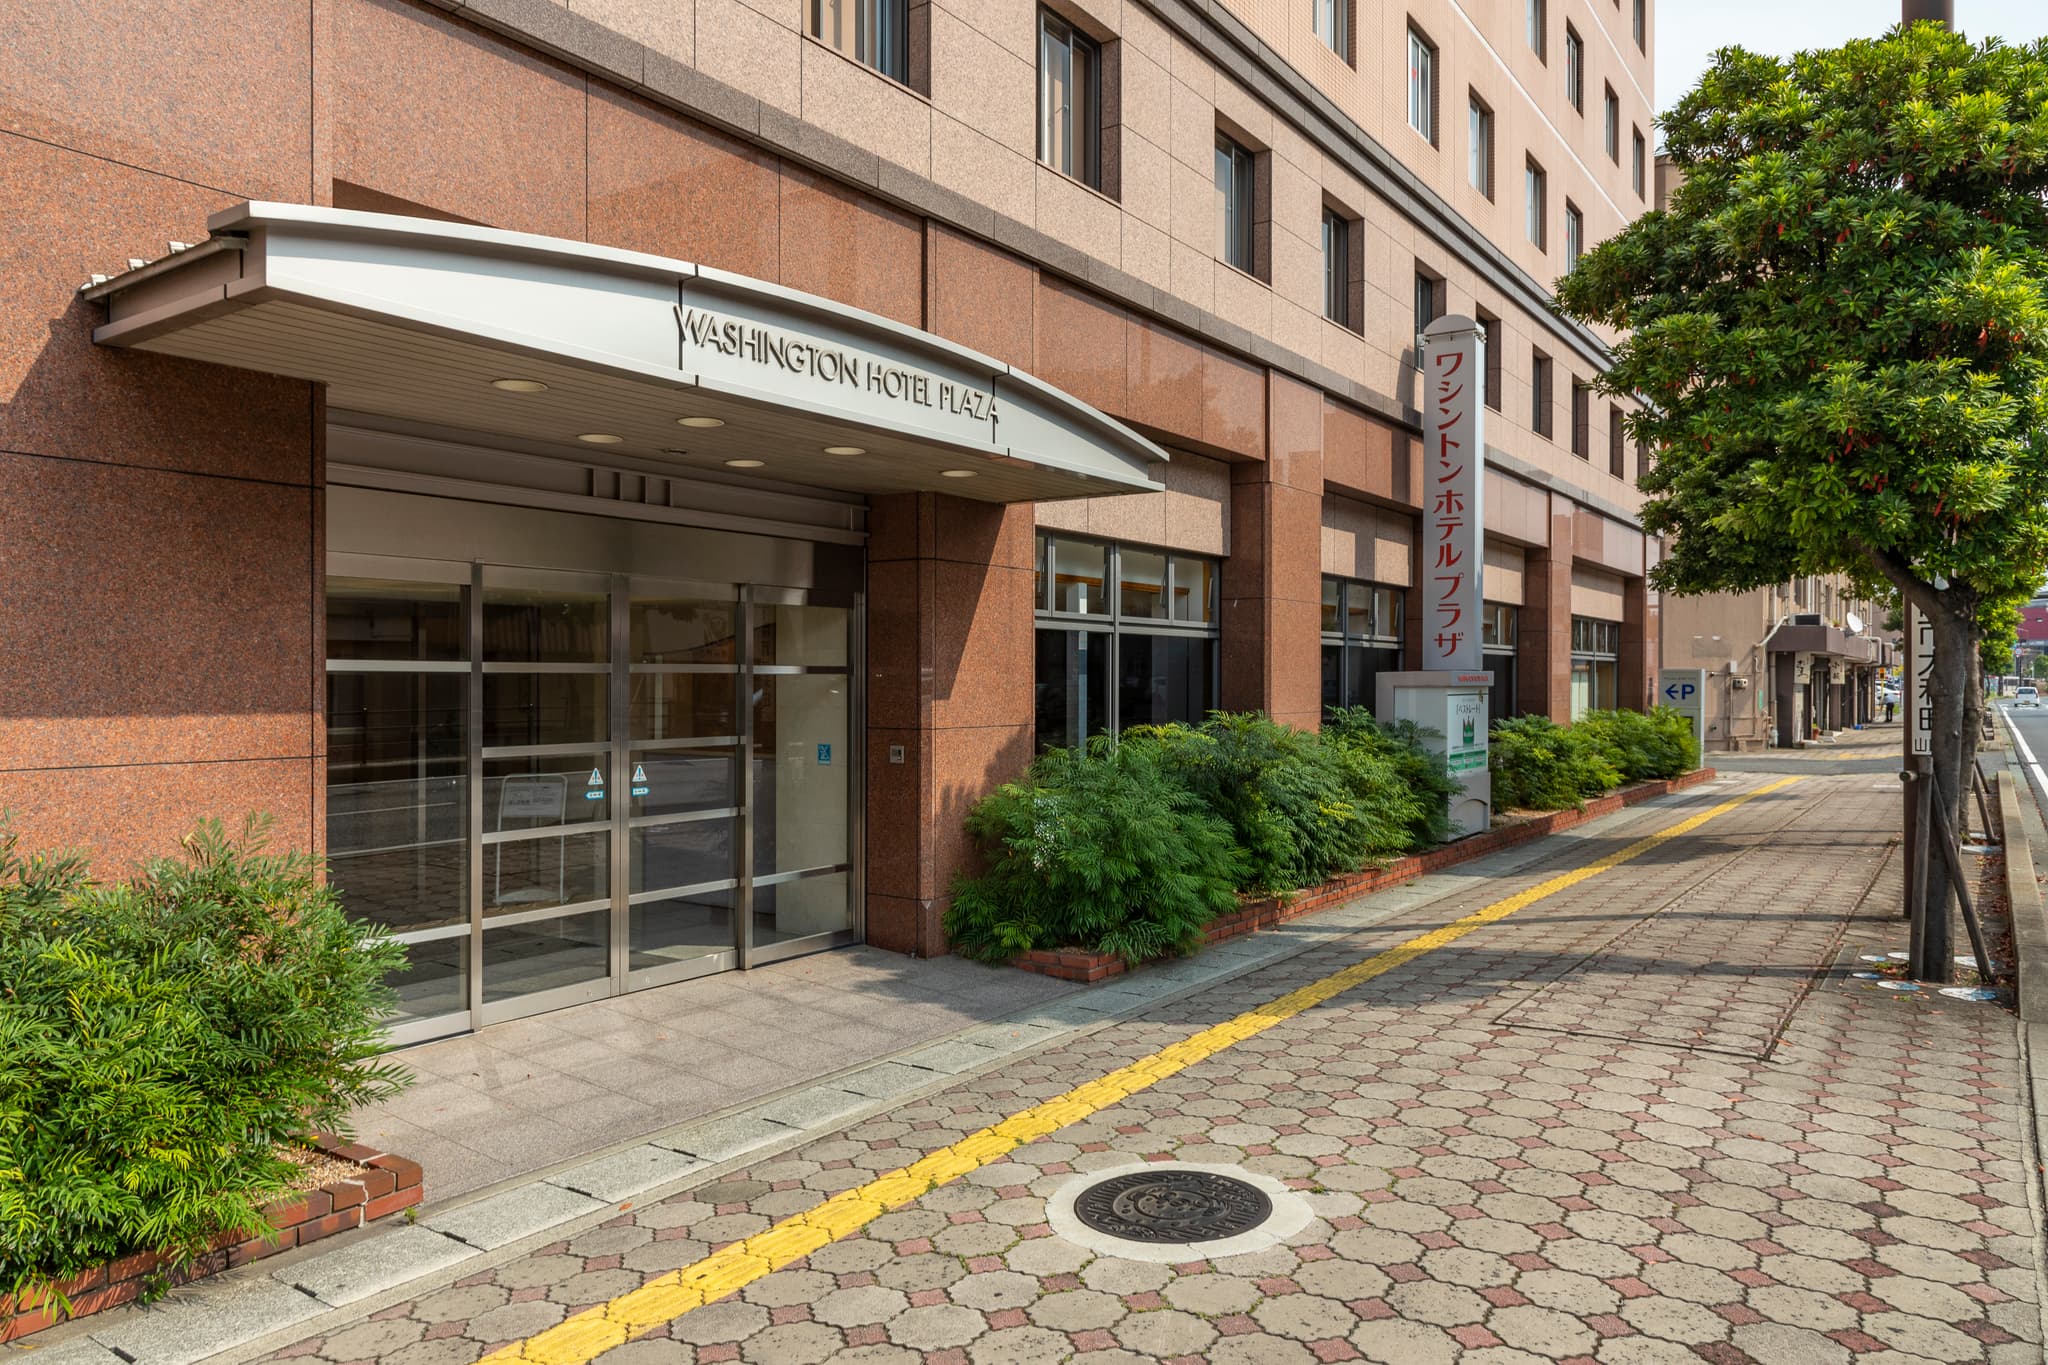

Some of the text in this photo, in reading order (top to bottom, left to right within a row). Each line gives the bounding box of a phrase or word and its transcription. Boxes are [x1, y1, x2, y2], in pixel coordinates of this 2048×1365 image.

[673, 305, 999, 424] WASHINGTON HOTEL PLAZA
[1433, 352, 1463, 658] ワシントンホテルプラザ
[1681, 684, 1695, 700] P
